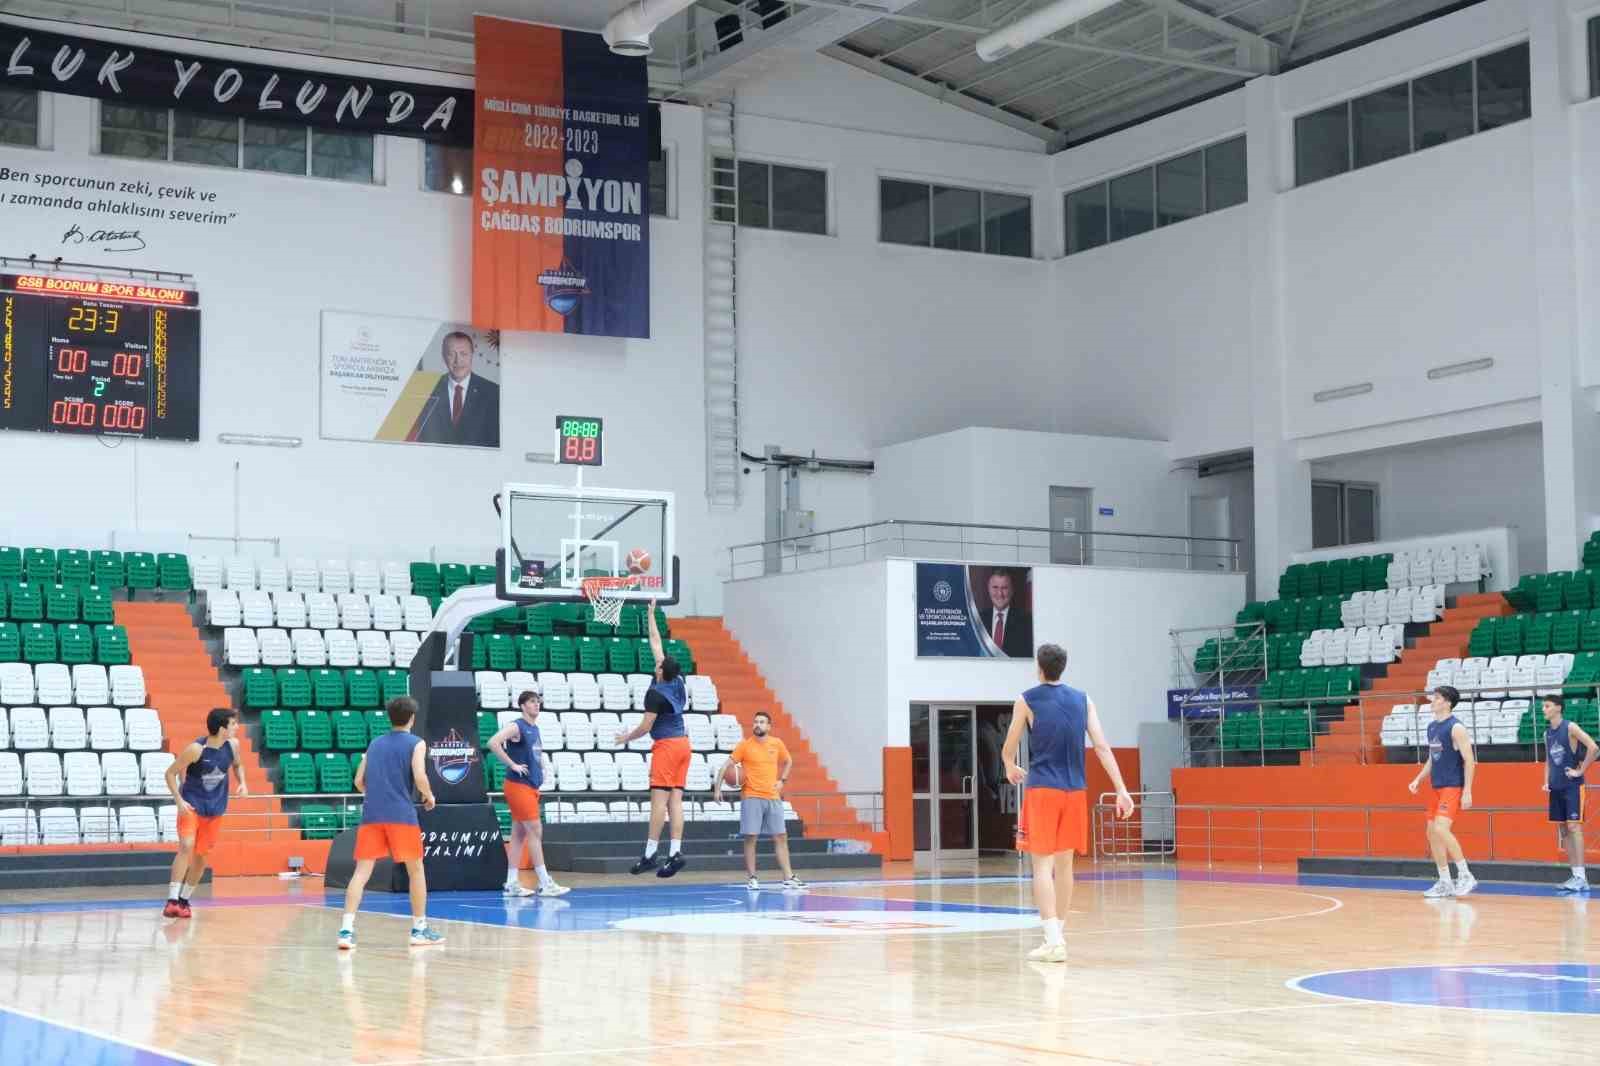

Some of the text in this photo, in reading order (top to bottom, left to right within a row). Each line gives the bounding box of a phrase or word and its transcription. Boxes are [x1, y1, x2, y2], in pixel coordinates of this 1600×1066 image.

[7, 37, 457, 131] LUK YOLUNDA
[573, 109, 622, 126] BASKETBOL
[525, 123, 599, 154] 2022-2023
[0, 168, 217, 202] Ben sporcunun zeki, çevik ve
[10, 192, 82, 210] zamanda
[88, 199, 165, 219] ahlaklısını
[481, 209, 641, 241] ÇAĞDAŞ BODRUMSPOR
[17, 276, 184, 300] GSB BODRUM SPOR SALONU
[58, 349, 88, 373] 00
[113, 353, 142, 377] 00
[94, 382, 104, 397] 2
[52, 401, 96, 426] 000
[103, 404, 145, 429] 000
